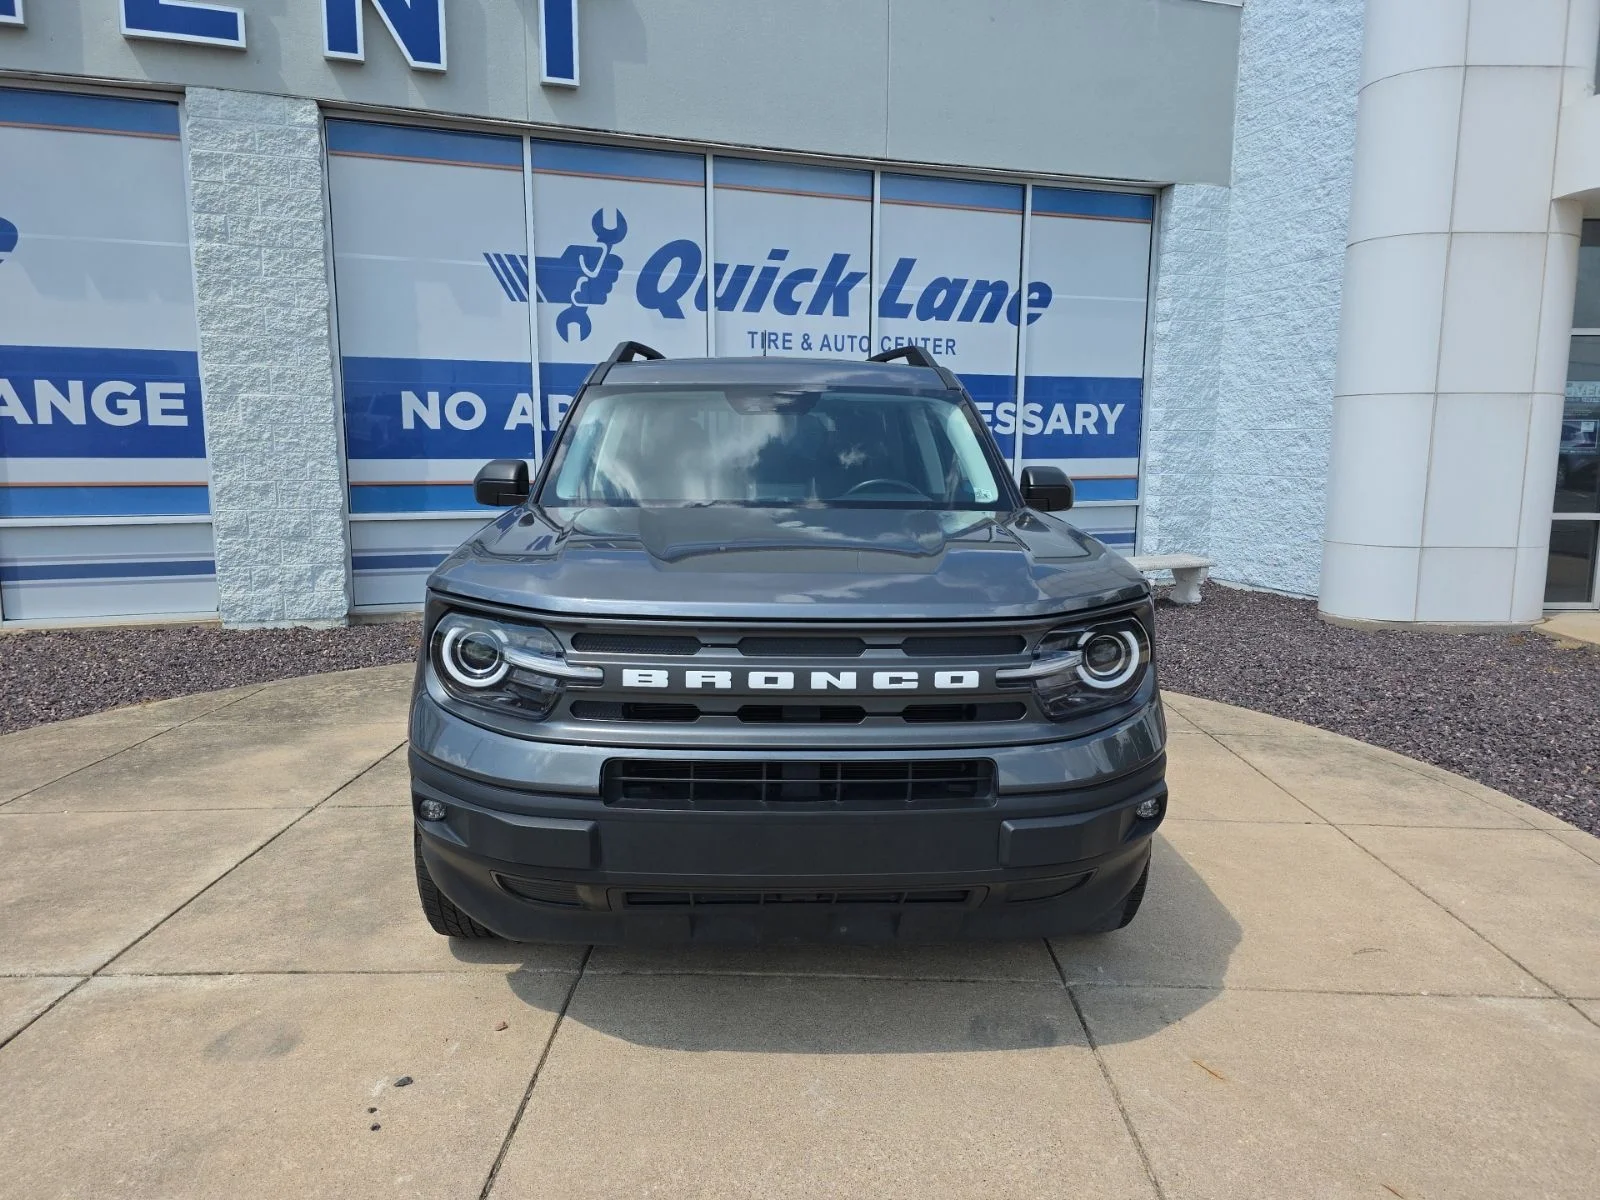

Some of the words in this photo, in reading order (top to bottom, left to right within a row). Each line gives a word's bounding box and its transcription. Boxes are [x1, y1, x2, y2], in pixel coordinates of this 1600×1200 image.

[636, 239, 867, 319] Quick
[878, 257, 1053, 327] Lane
[747, 331, 793, 350] TIRE
[800, 332, 813, 351] &
[819, 334, 871, 353] AUTO
[401, 390, 487, 431] NO
[622, 669, 980, 690] BRONCO
